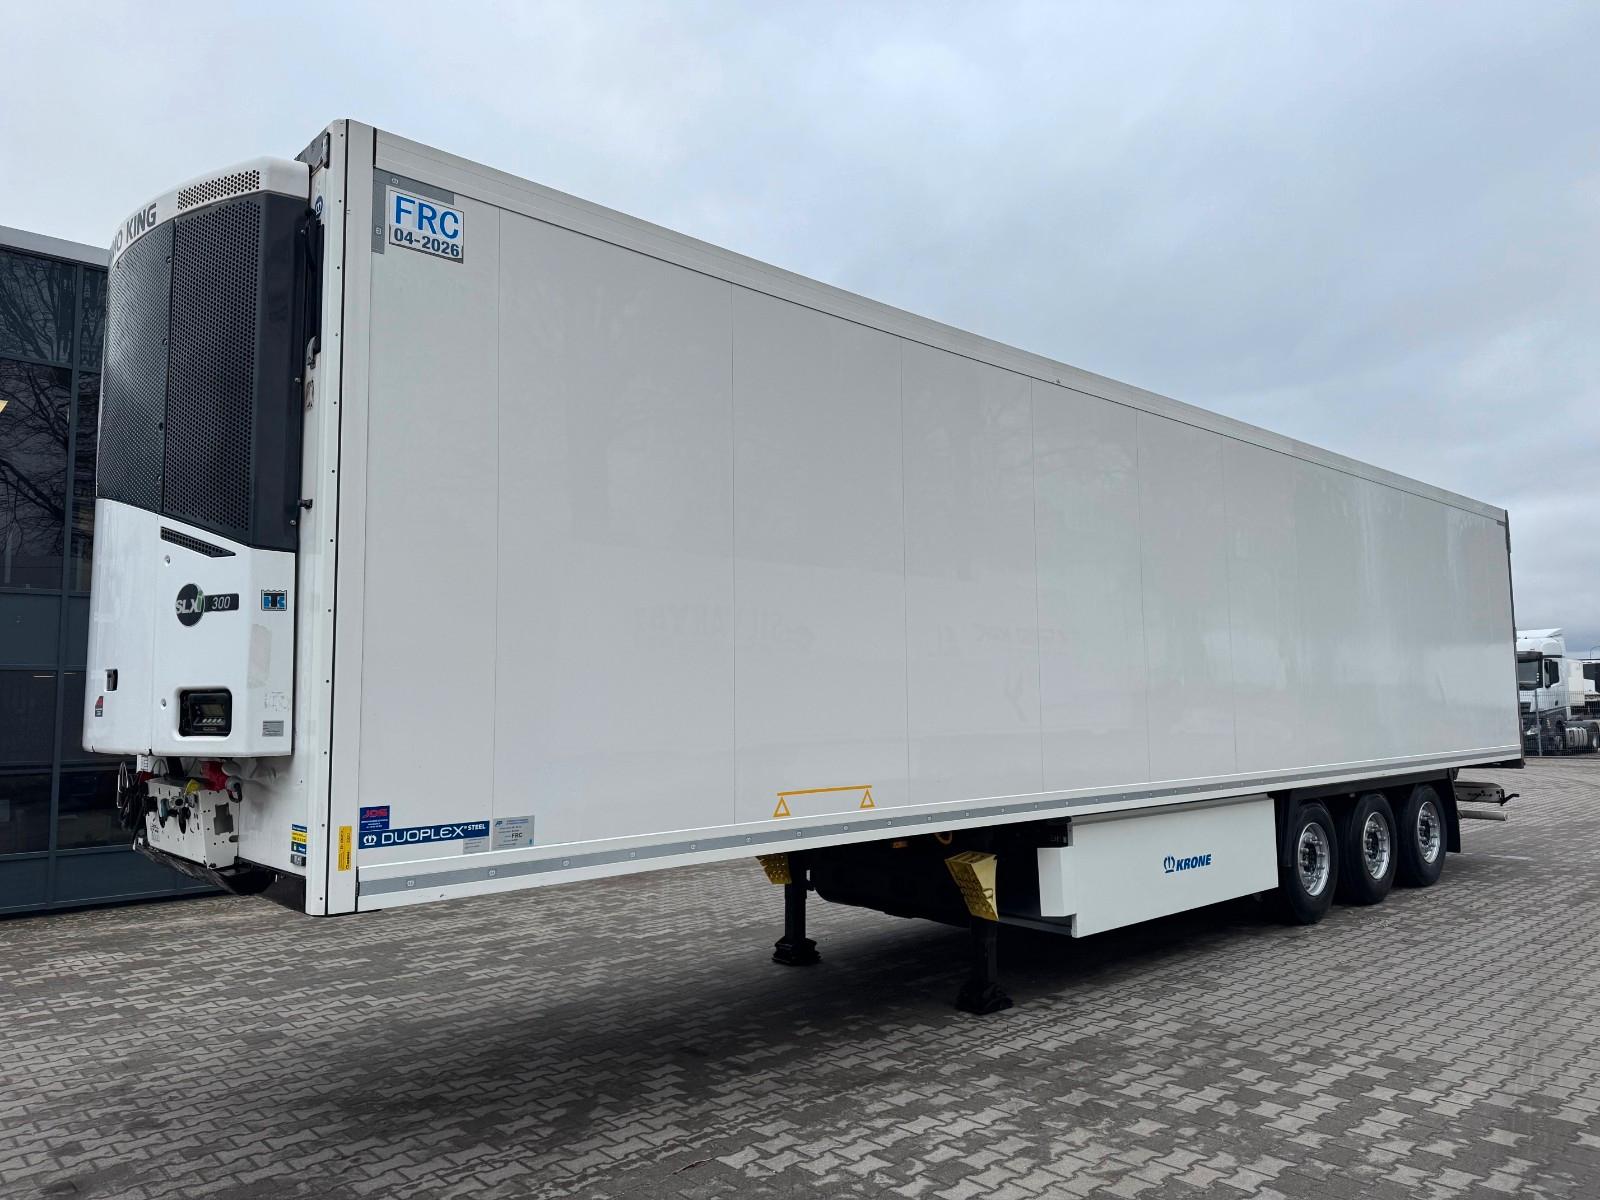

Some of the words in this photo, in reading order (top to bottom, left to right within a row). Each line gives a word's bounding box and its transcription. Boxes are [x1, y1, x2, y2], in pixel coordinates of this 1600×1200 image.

[126, 202, 157, 244] KING
[395, 195, 459, 240] FRC
[393, 227, 460, 257] 04-2026
[211, 596, 231, 610] 300
[381, 826, 465, 845] DUOPLEX
[1175, 853, 1212, 872] KRONE
